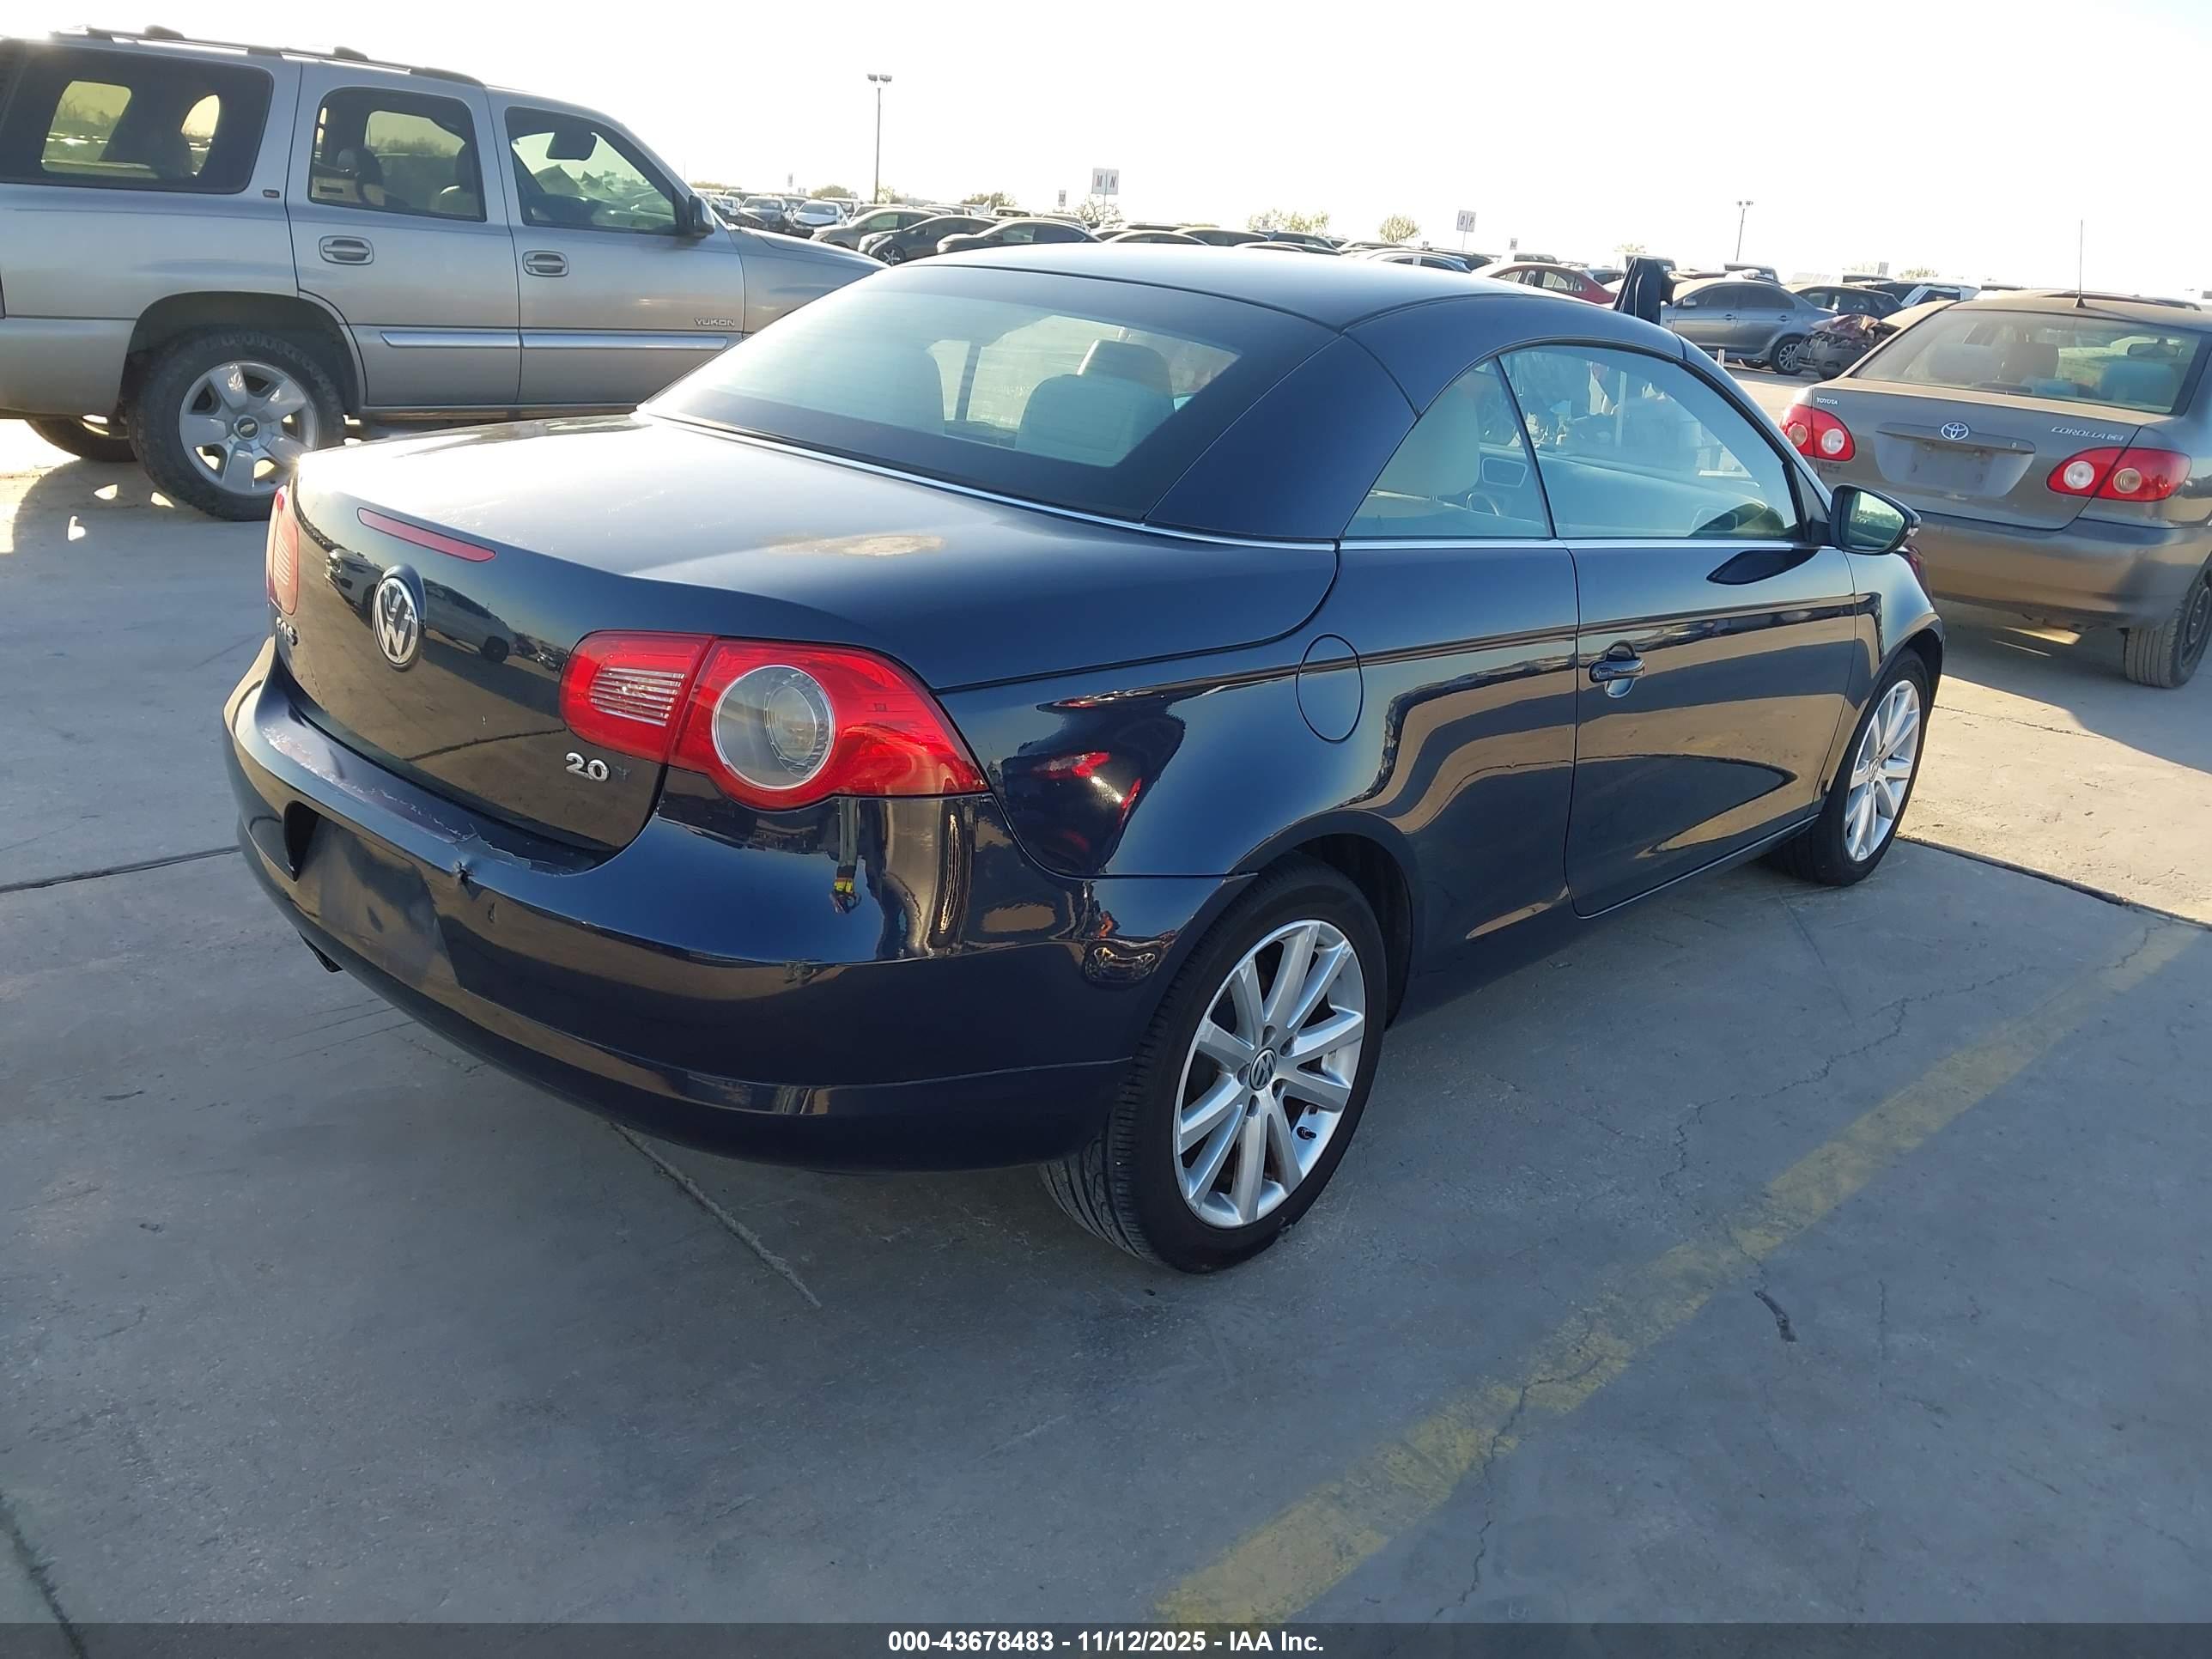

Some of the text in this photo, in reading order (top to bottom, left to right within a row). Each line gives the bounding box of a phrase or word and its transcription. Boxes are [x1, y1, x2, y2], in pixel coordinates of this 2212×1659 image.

[694, 318, 735, 326] YUKON
[1816, 397, 1838, 405] TOYOTA
[2051, 427, 2106, 439] COROLLA
